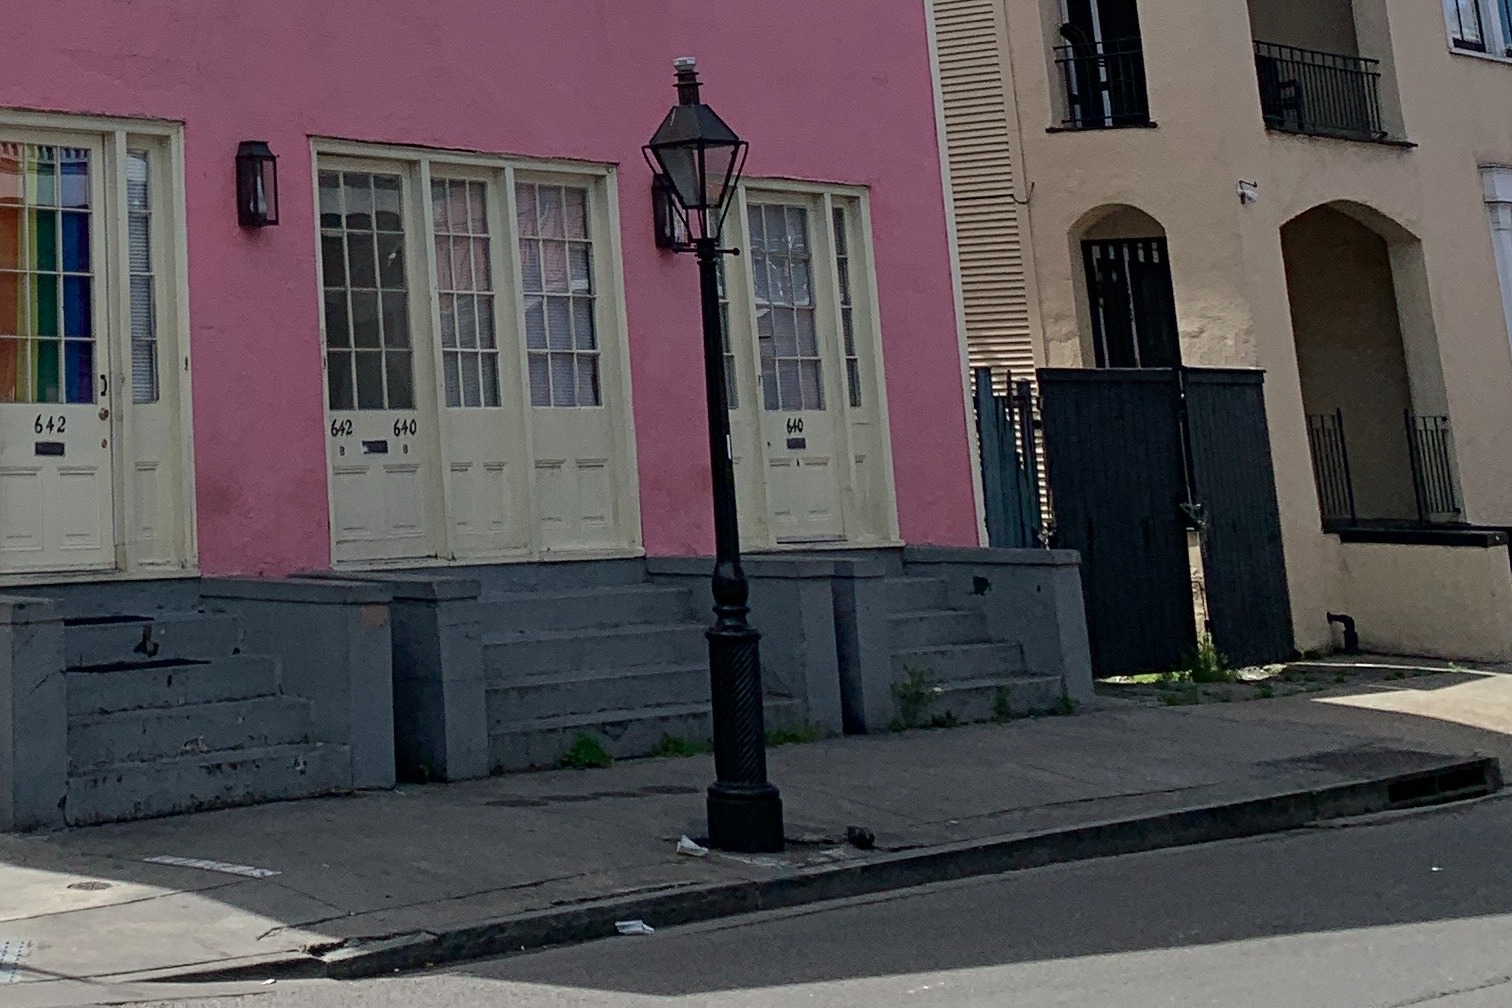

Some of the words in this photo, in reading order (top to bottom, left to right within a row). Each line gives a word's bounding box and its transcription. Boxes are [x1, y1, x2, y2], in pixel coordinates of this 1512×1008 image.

[34, 414, 66, 434] 642
[331, 418, 353, 437] 642
[393, 418, 417, 437] 640
[786, 417, 804, 434] 640
